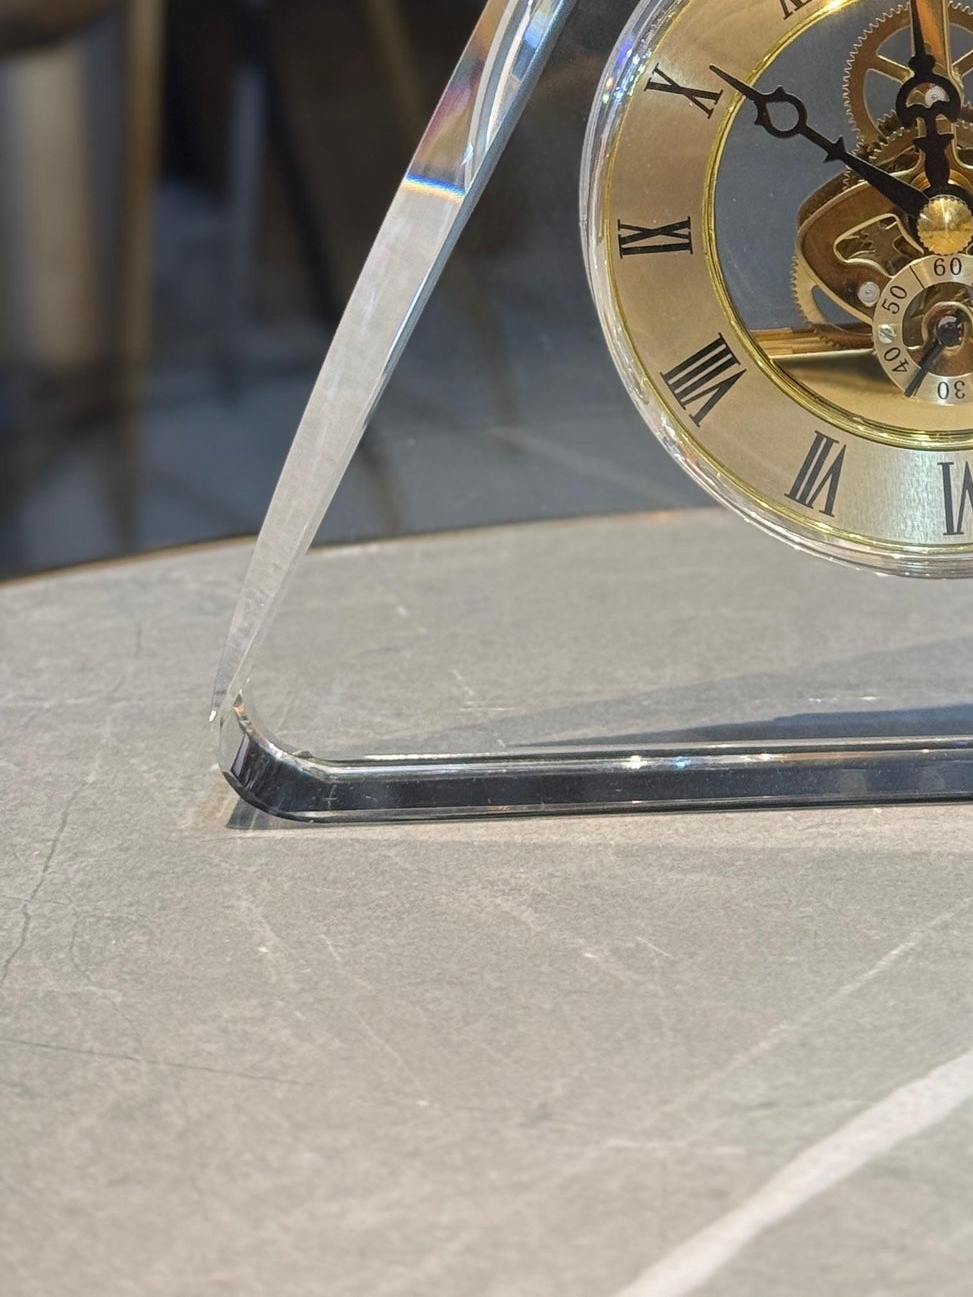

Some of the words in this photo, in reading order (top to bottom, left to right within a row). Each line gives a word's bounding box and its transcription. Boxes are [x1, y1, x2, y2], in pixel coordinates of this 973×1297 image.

[644, 63, 723, 119] X
[617, 216, 692, 259] IX
[933, 257, 962, 276] 60
[881, 285, 907, 314] 50
[883, 347, 909, 373] 40
[659, 332, 747, 427] VIII
[937, 380, 965, 399] 30
[784, 429, 849, 517] VII
